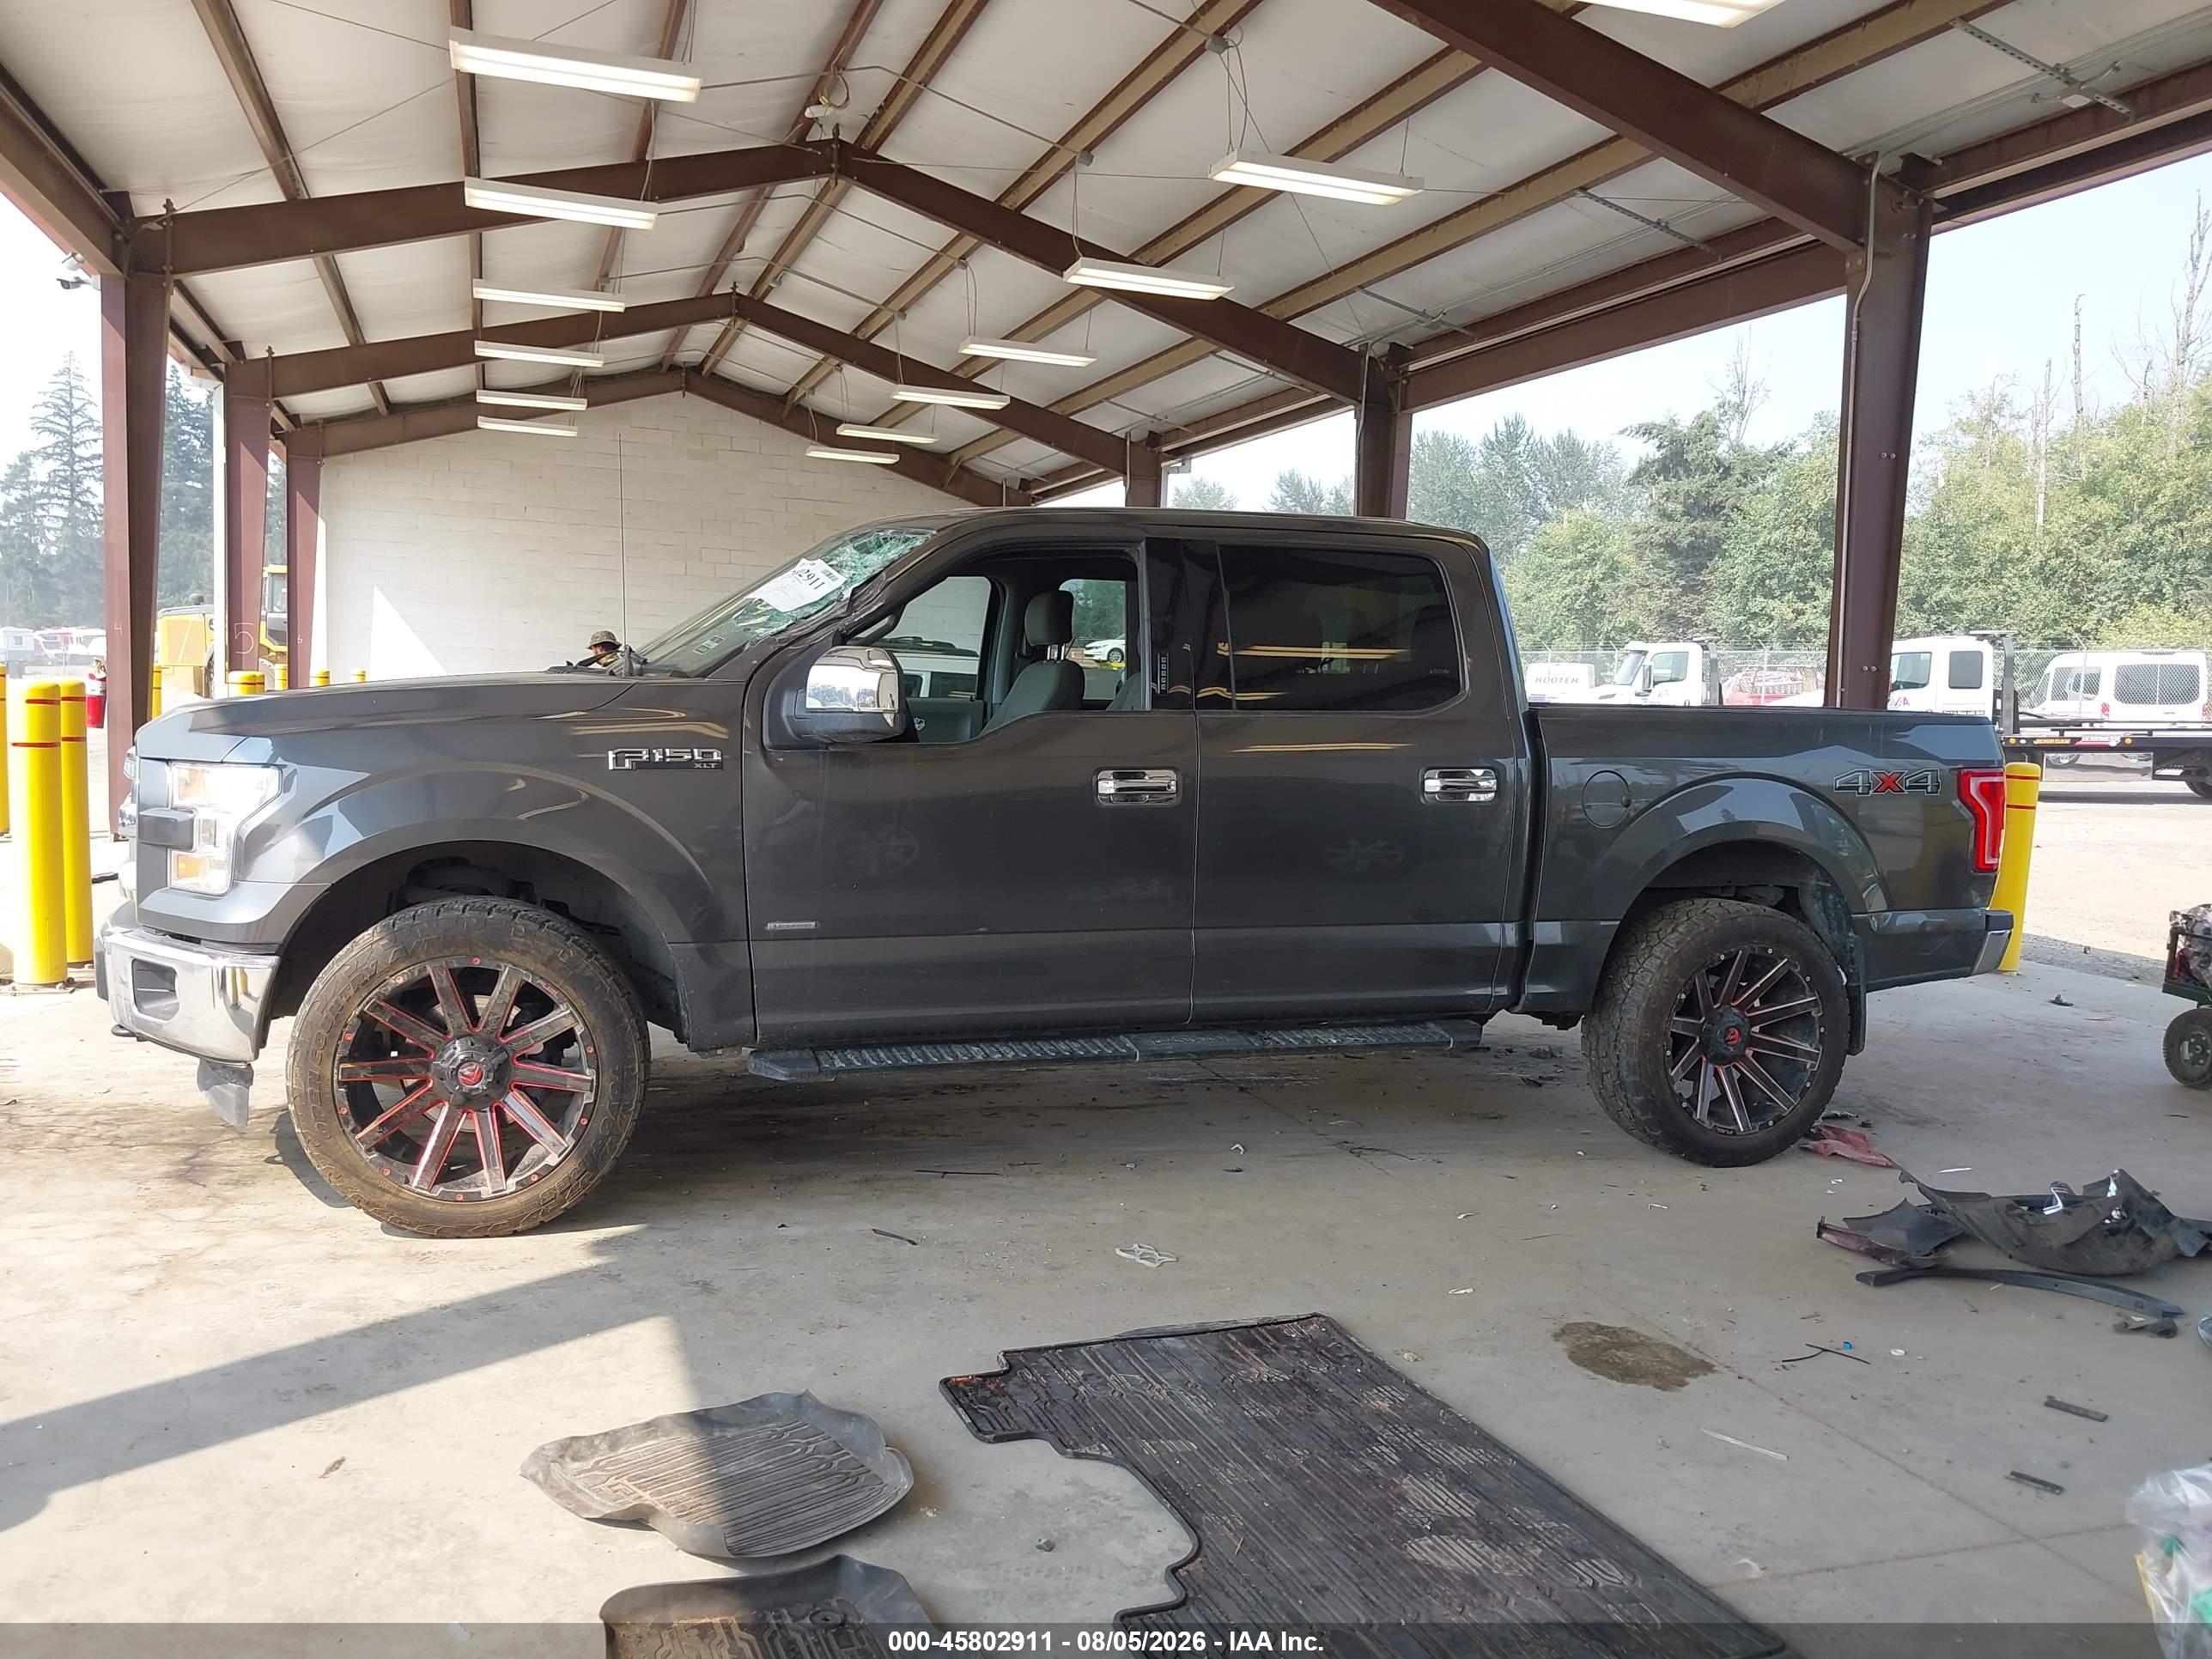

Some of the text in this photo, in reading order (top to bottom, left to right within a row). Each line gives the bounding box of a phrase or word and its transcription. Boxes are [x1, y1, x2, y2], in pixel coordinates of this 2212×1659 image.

[113, 622, 124, 636] 4
[234, 622, 256, 654] 5
[296, 634, 303, 644] 6
[1534, 676, 1579, 684] ROOTER
[307, 958, 380, 1139] OPEN COUNTRY
